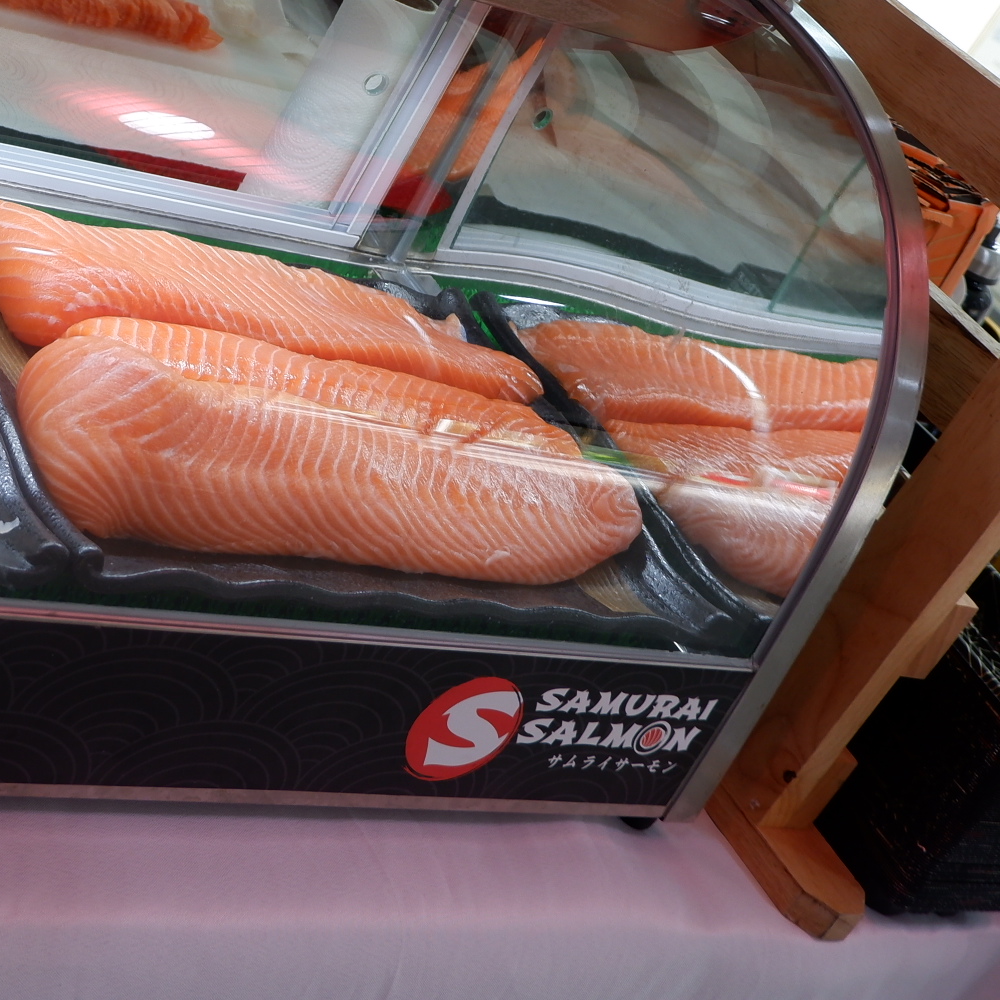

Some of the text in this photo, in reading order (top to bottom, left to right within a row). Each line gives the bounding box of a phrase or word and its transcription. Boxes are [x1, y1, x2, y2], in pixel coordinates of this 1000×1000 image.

[535, 688, 719, 721] SAMURAI
[516, 717, 702, 756] SALMON
[548, 754, 678, 773] サムライサーモン
